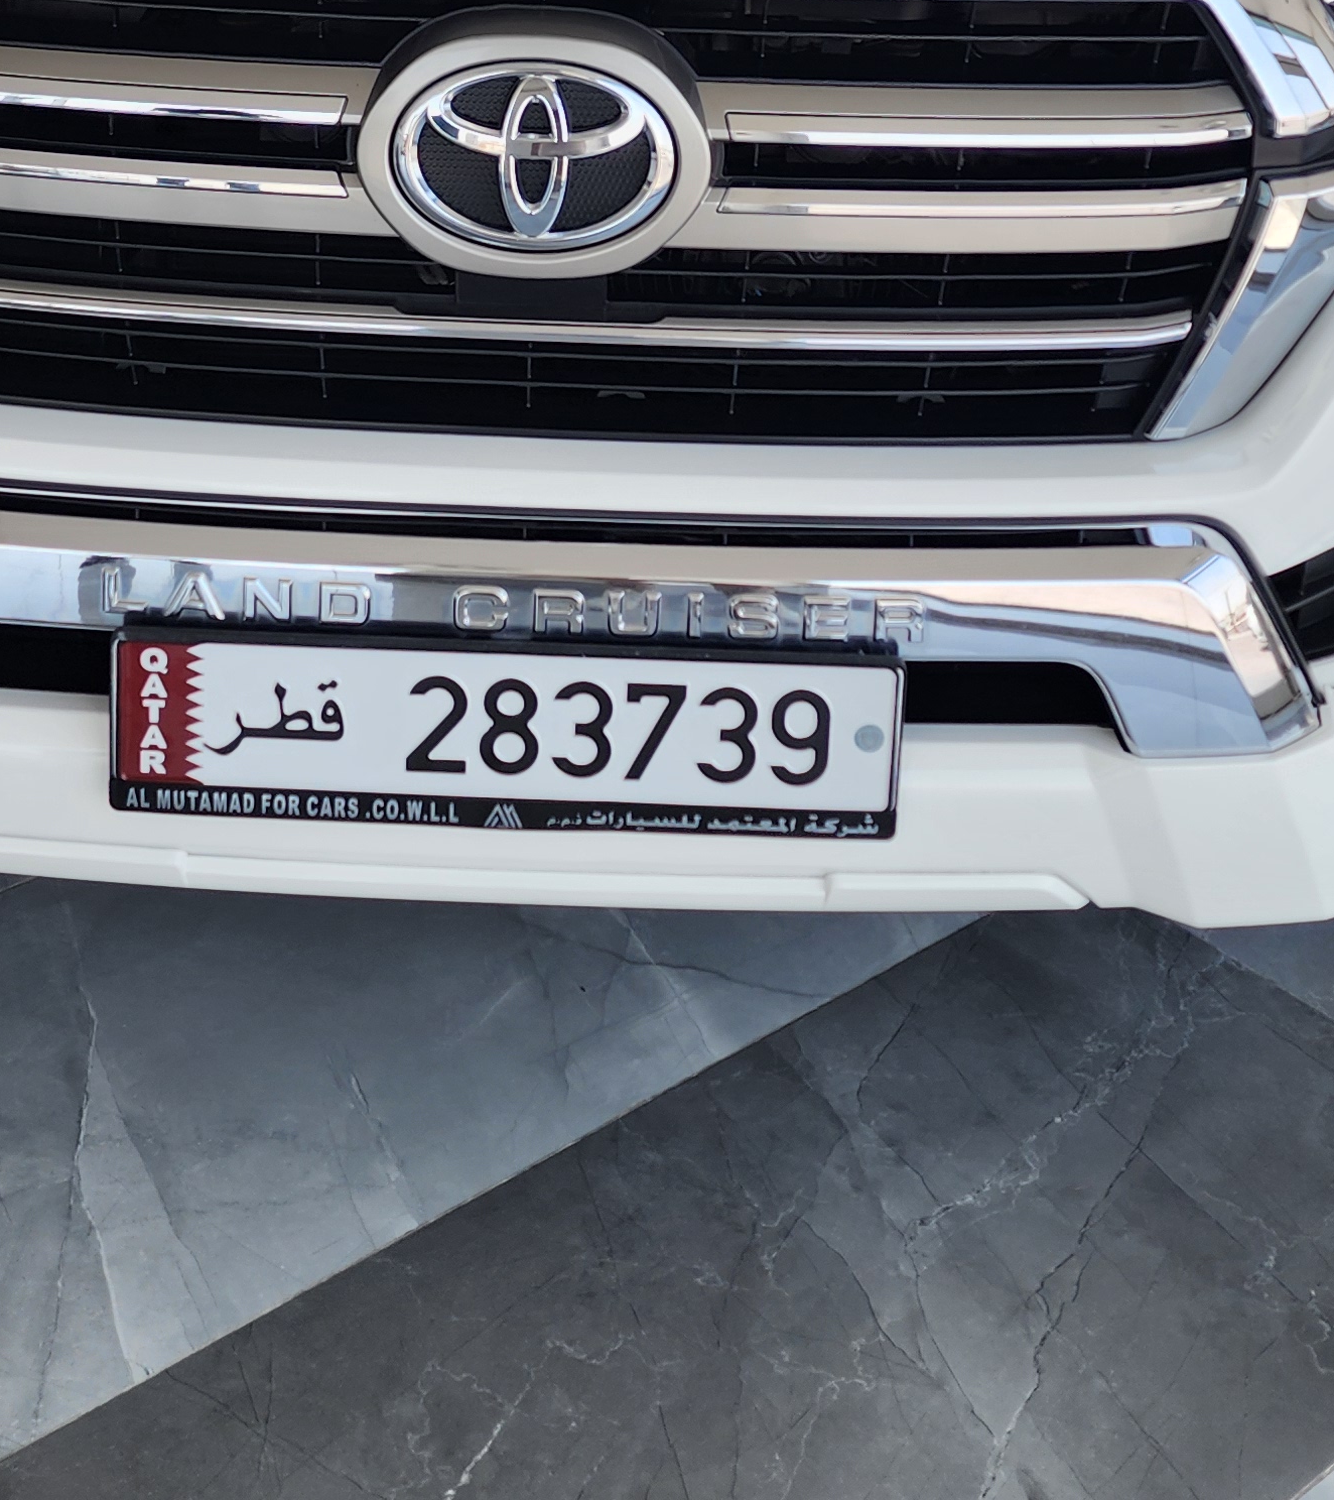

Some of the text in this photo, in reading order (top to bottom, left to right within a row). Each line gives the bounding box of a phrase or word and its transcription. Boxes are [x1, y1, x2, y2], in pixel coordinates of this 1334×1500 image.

[100, 566, 928, 646] LAND CRUISER
[138, 647, 169, 777] QATAR
[202, 680, 346, 756] قطر
[405, 675, 832, 787] 283739
[126, 787, 150, 809] AL
[156, 788, 255, 814] MUTAMAD
[261, 793, 301, 816] FOR
[306, 795, 359, 819] CARS
[585, 809, 703, 832] للسيارات
[707, 813, 797, 834] المعتمد
[803, 813, 880, 838] شركة
